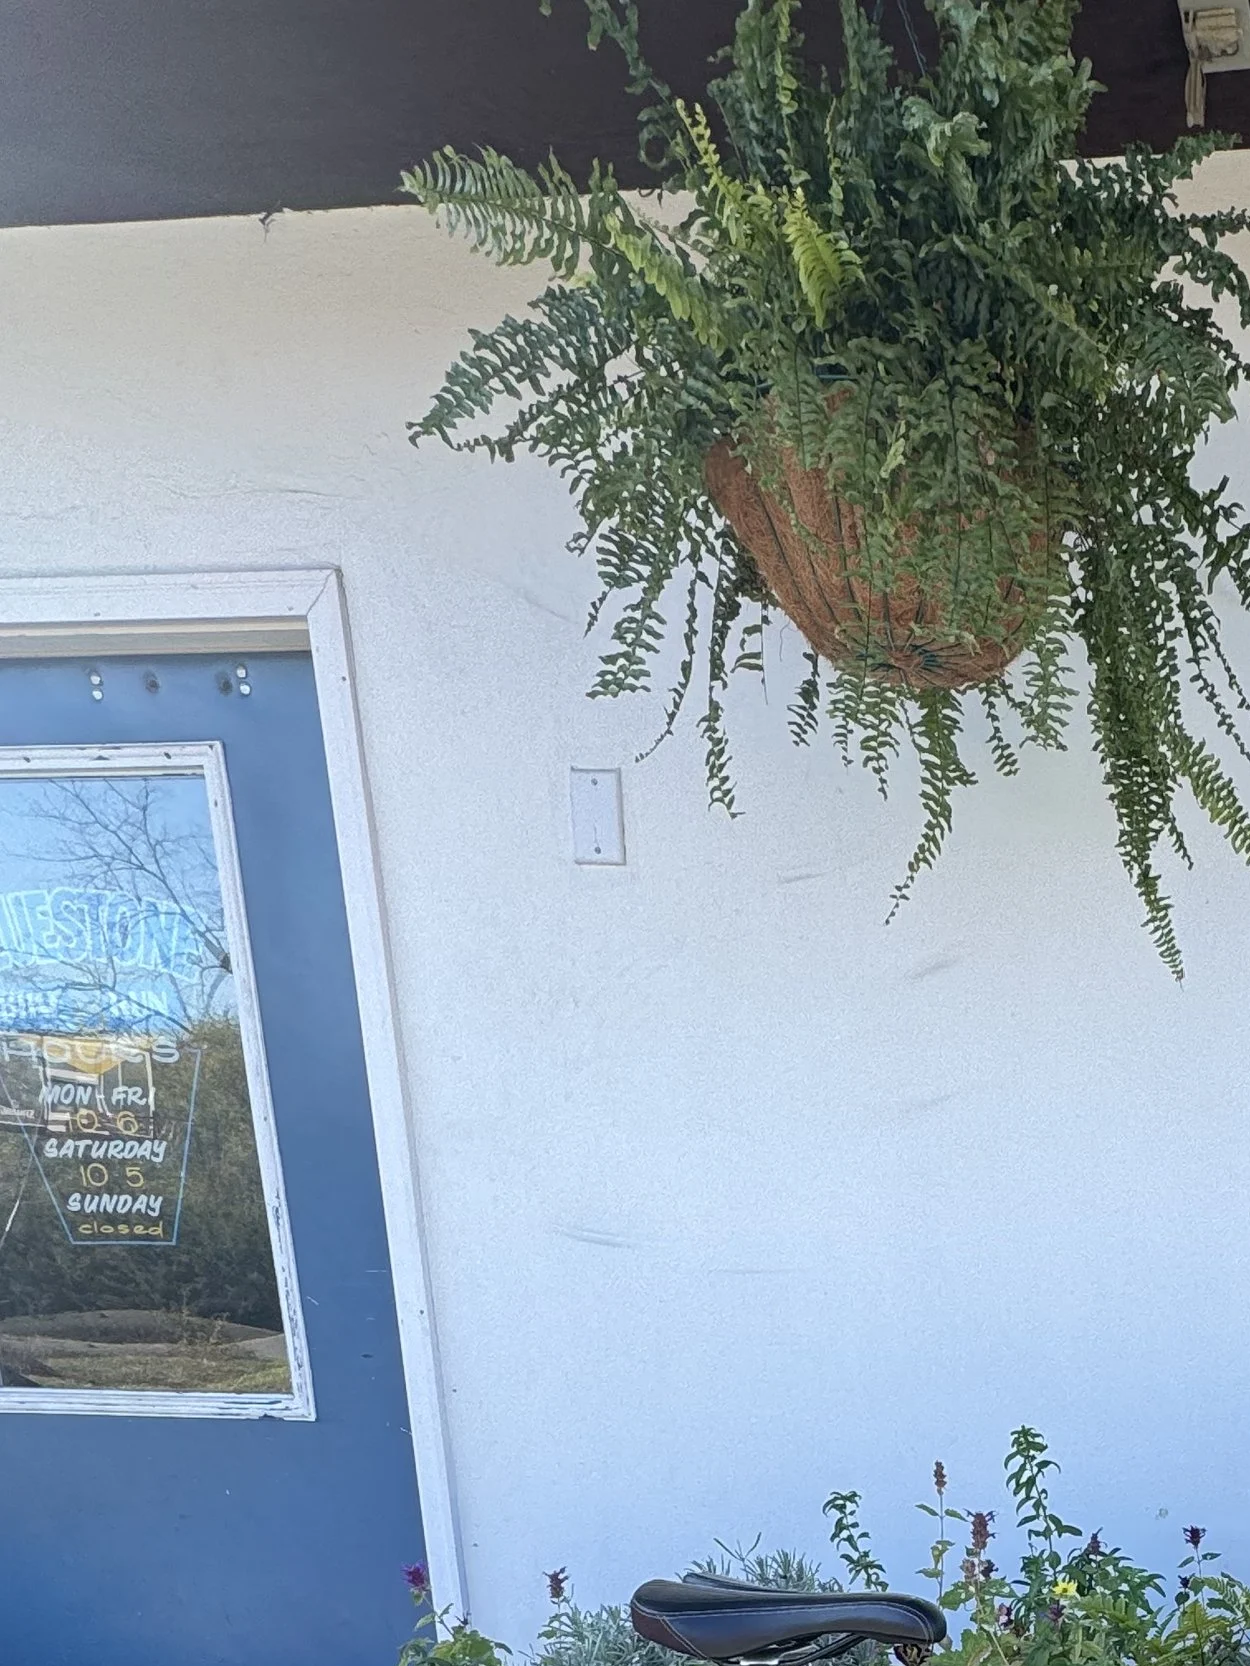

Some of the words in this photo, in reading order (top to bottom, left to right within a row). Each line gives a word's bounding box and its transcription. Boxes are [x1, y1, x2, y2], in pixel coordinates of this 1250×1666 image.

[2, 1033, 180, 1064] HOURS
[116, 1110, 139, 1134] 6
[43, 1138, 168, 1163] SATURDAY
[80, 1162, 109, 1187] 10
[125, 1166, 145, 1187] 5
[66, 1191, 163, 1217] SUNDAY
[78, 1221, 164, 1238] closed
